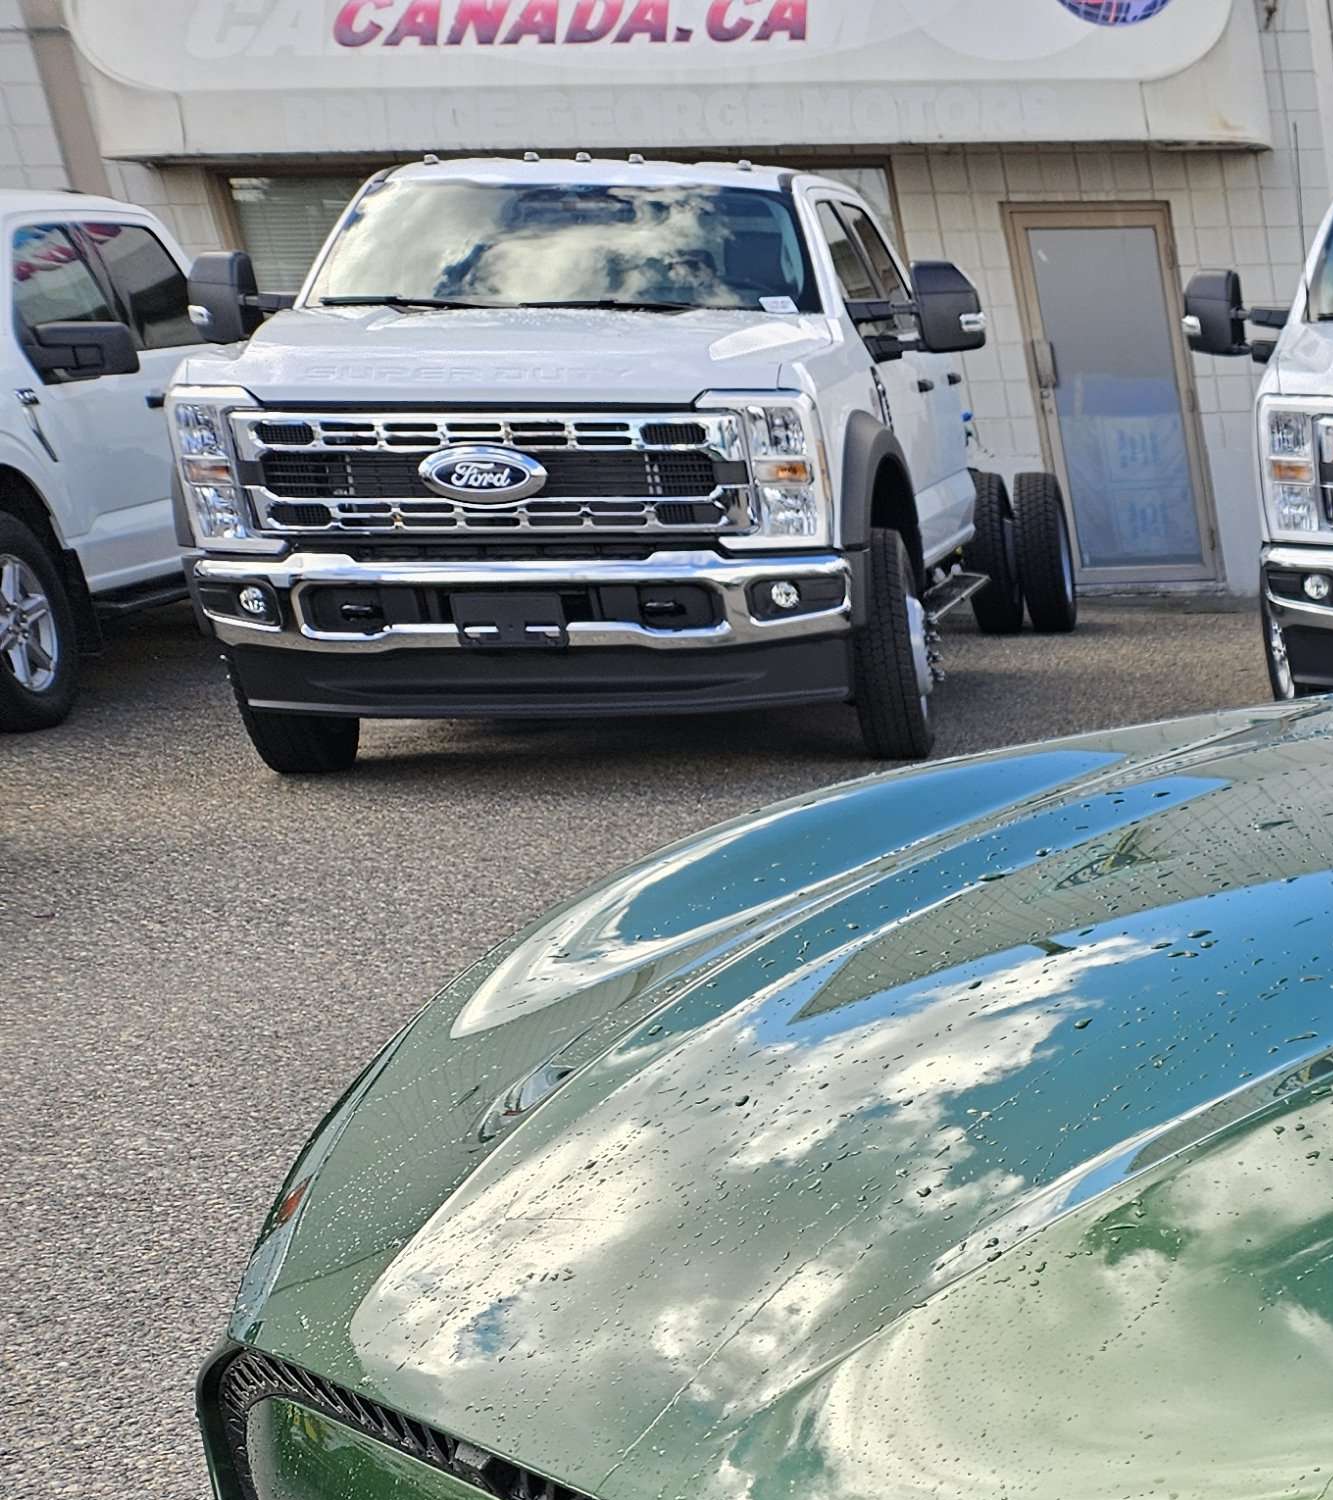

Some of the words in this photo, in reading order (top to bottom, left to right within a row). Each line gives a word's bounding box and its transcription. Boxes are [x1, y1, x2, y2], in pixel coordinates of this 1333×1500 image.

[333, 0, 806, 47] CANADA.CA
[305, 365, 474, 382] SUPER
[450, 462, 511, 487] Ford
